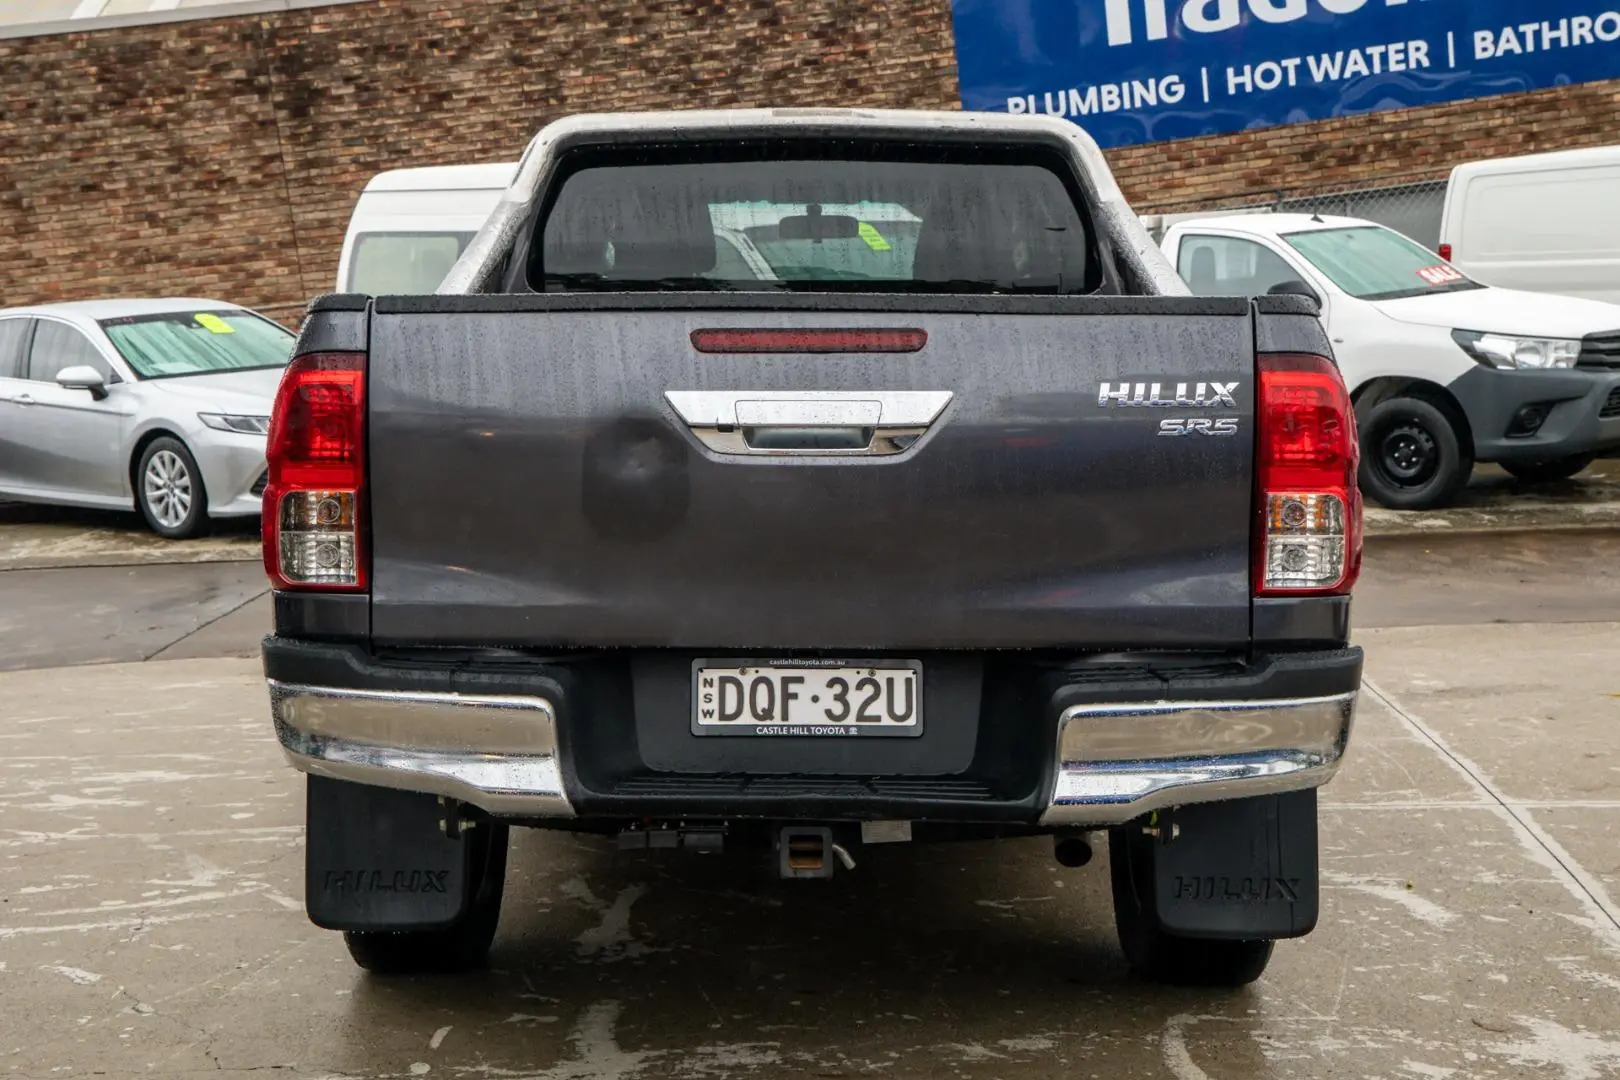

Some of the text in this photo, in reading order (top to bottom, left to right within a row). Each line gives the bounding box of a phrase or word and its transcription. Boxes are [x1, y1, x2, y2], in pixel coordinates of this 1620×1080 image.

[1007, 75, 1185, 117] PLUMBING
[1226, 57, 1301, 95] HOT
[1306, 39, 1430, 83] WATER
[1473, 11, 1620, 60] BATHRO
[1098, 382, 1240, 407] HILUX
[1157, 418, 1240, 436] SR5
[769, 659, 846, 667] castlehilltoyota.com.au
[756, 726, 846, 735] CASTLE HILL TOYOTA
[324, 870, 450, 893] HILUX
[1174, 876, 1302, 900] HILUX
